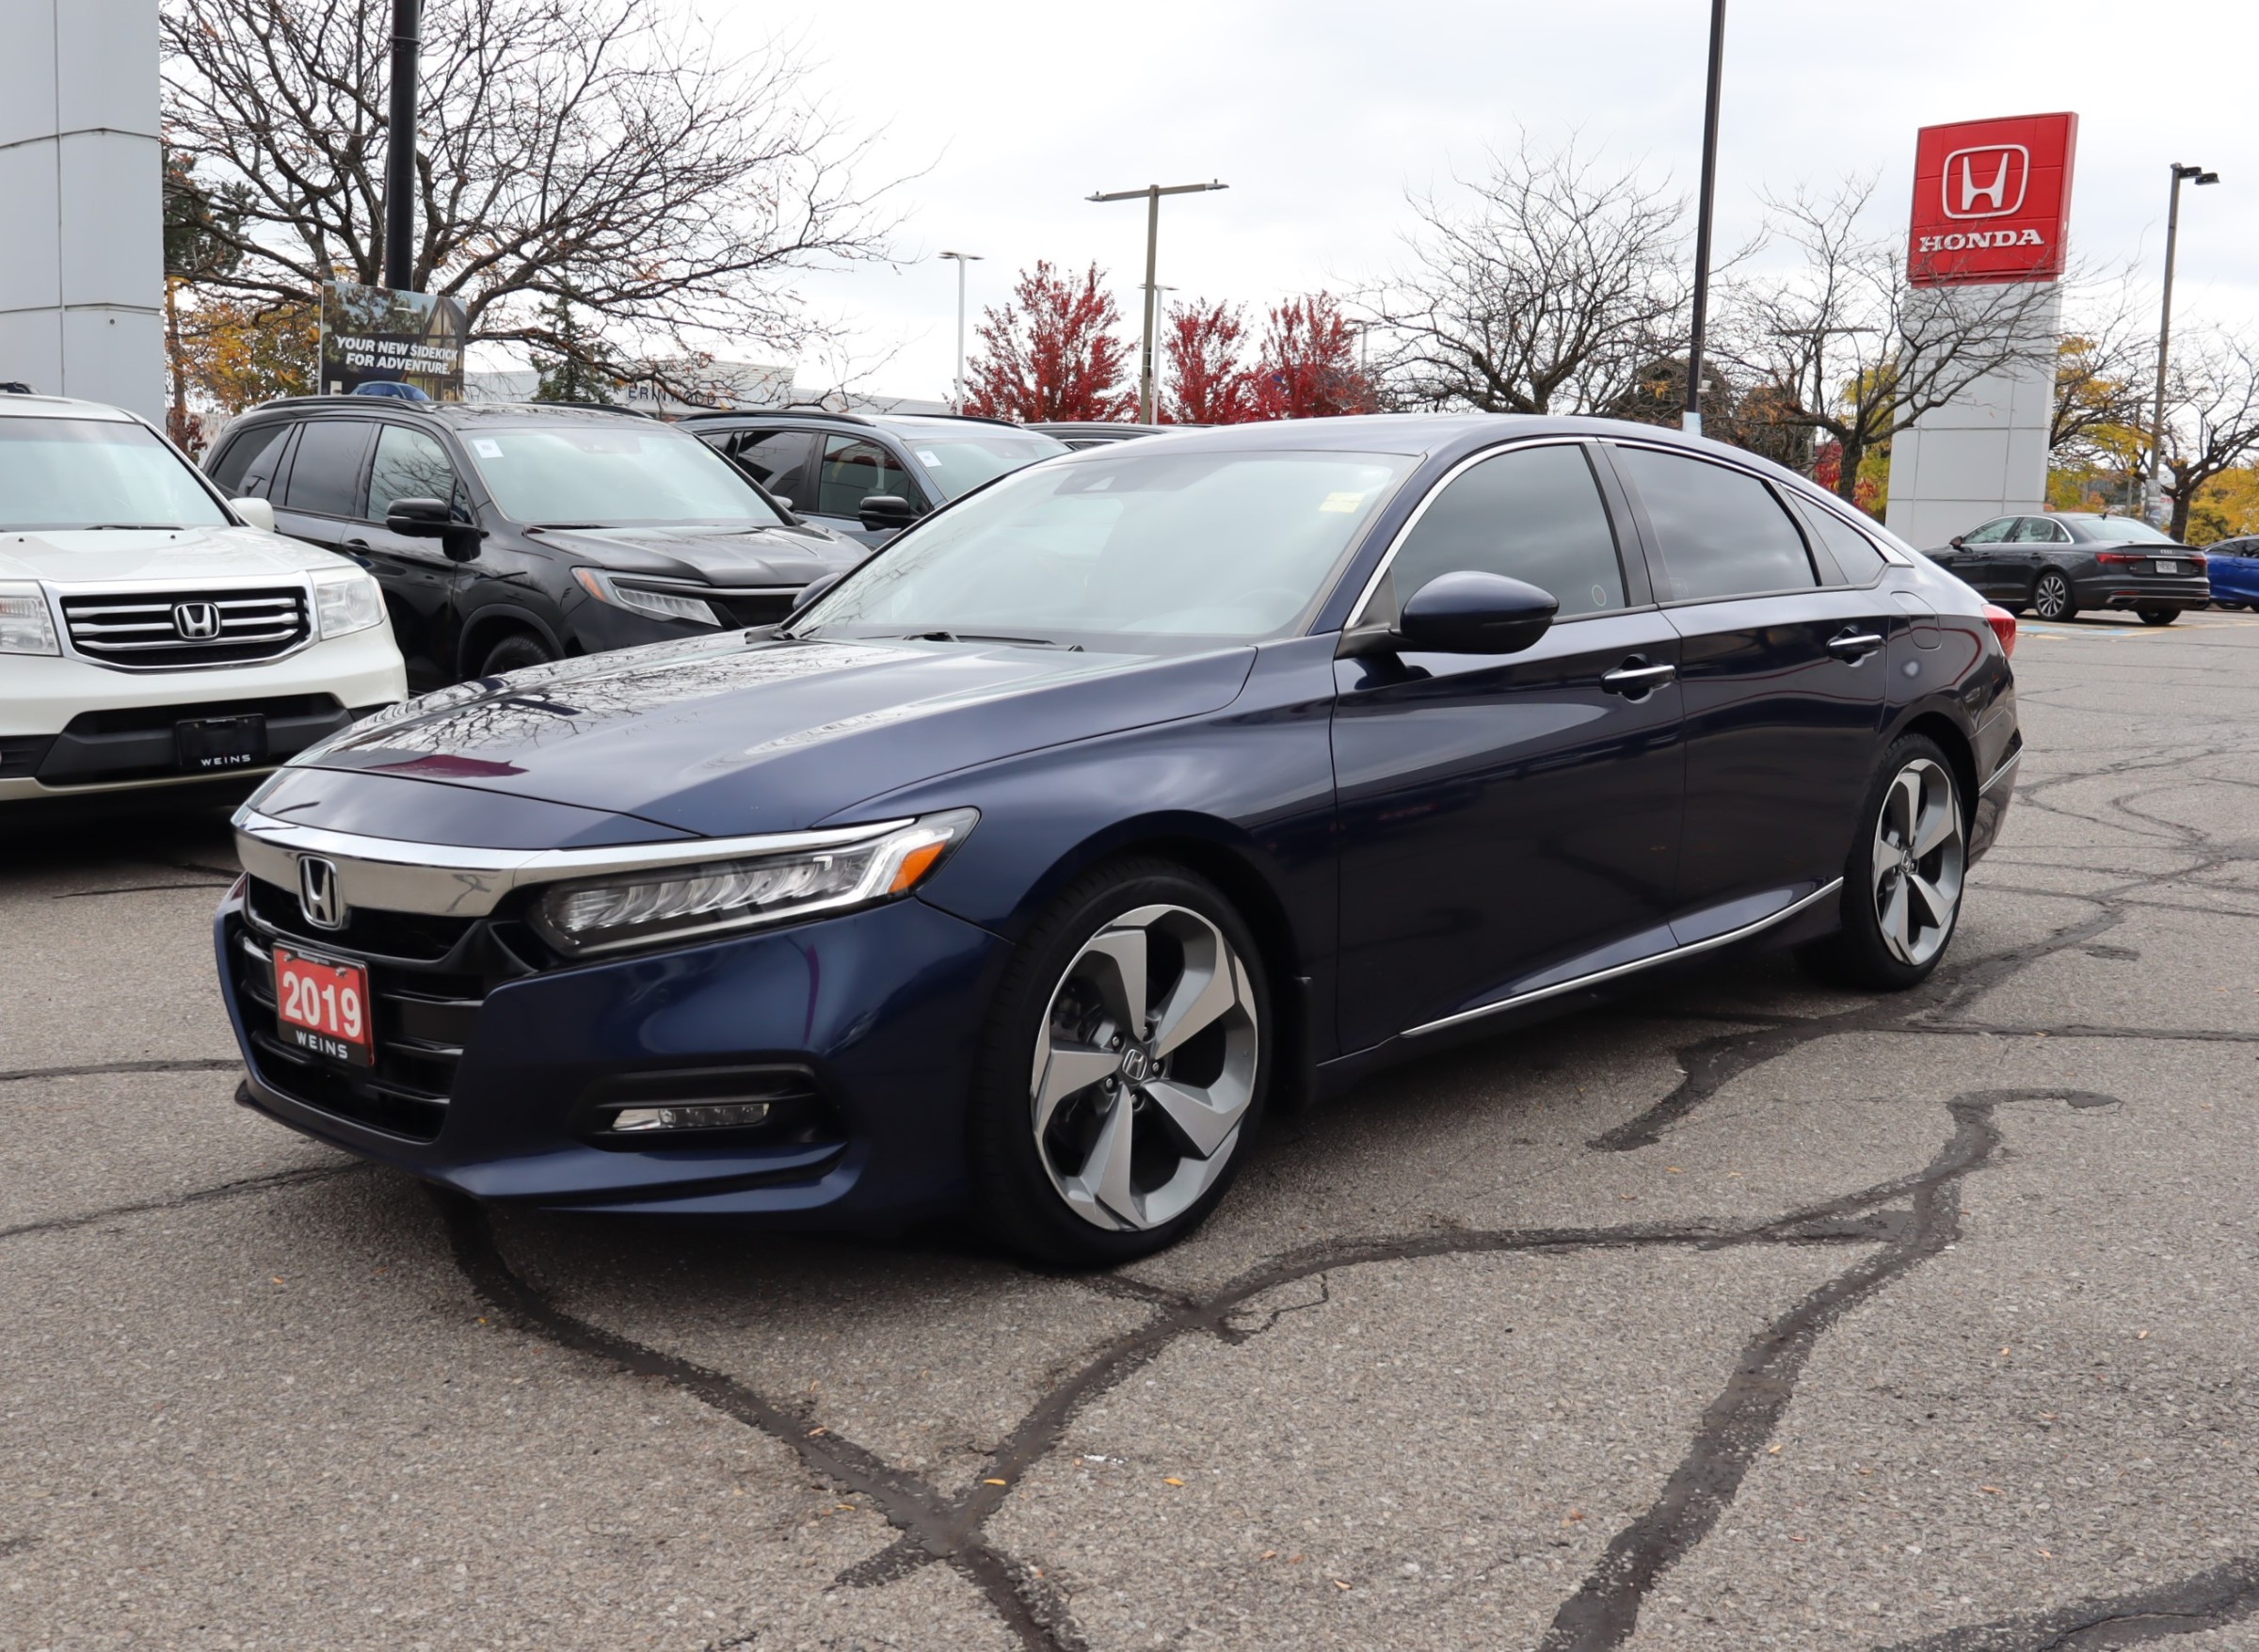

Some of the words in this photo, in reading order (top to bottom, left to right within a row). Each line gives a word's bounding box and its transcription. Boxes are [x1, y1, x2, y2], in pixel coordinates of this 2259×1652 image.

[1918, 229, 2043, 253] HONDA
[335, 335, 375, 353] YOUR
[377, 341, 409, 356] NEW
[409, 344, 458, 361] SIDEKICK
[345, 352, 375, 367] FOR
[376, 356, 451, 375] ADVENTURE.
[200, 754, 251, 766] WEINS
[282, 970, 361, 1038] 2019
[296, 1030, 348, 1060] WEINS
